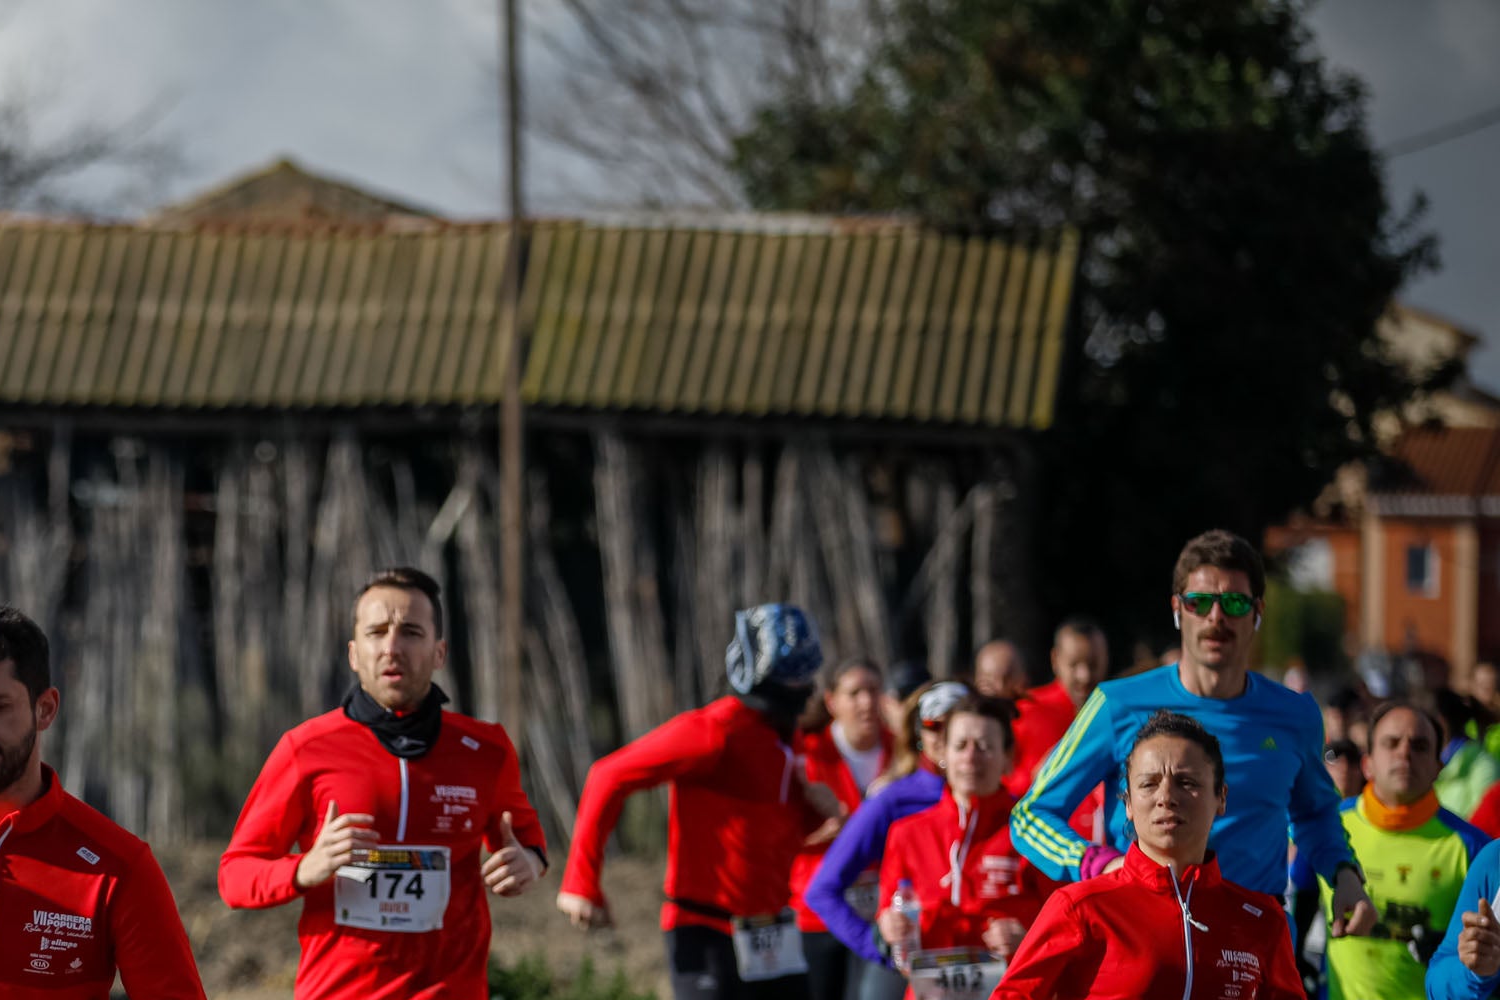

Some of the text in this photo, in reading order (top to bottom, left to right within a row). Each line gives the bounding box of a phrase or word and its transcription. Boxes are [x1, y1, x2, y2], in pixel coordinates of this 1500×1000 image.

[366, 872, 424, 900] 174
[33, 910, 48, 926] VII
[48, 912, 92, 925] CARRERA
[47, 920, 91, 931] POPULAR
